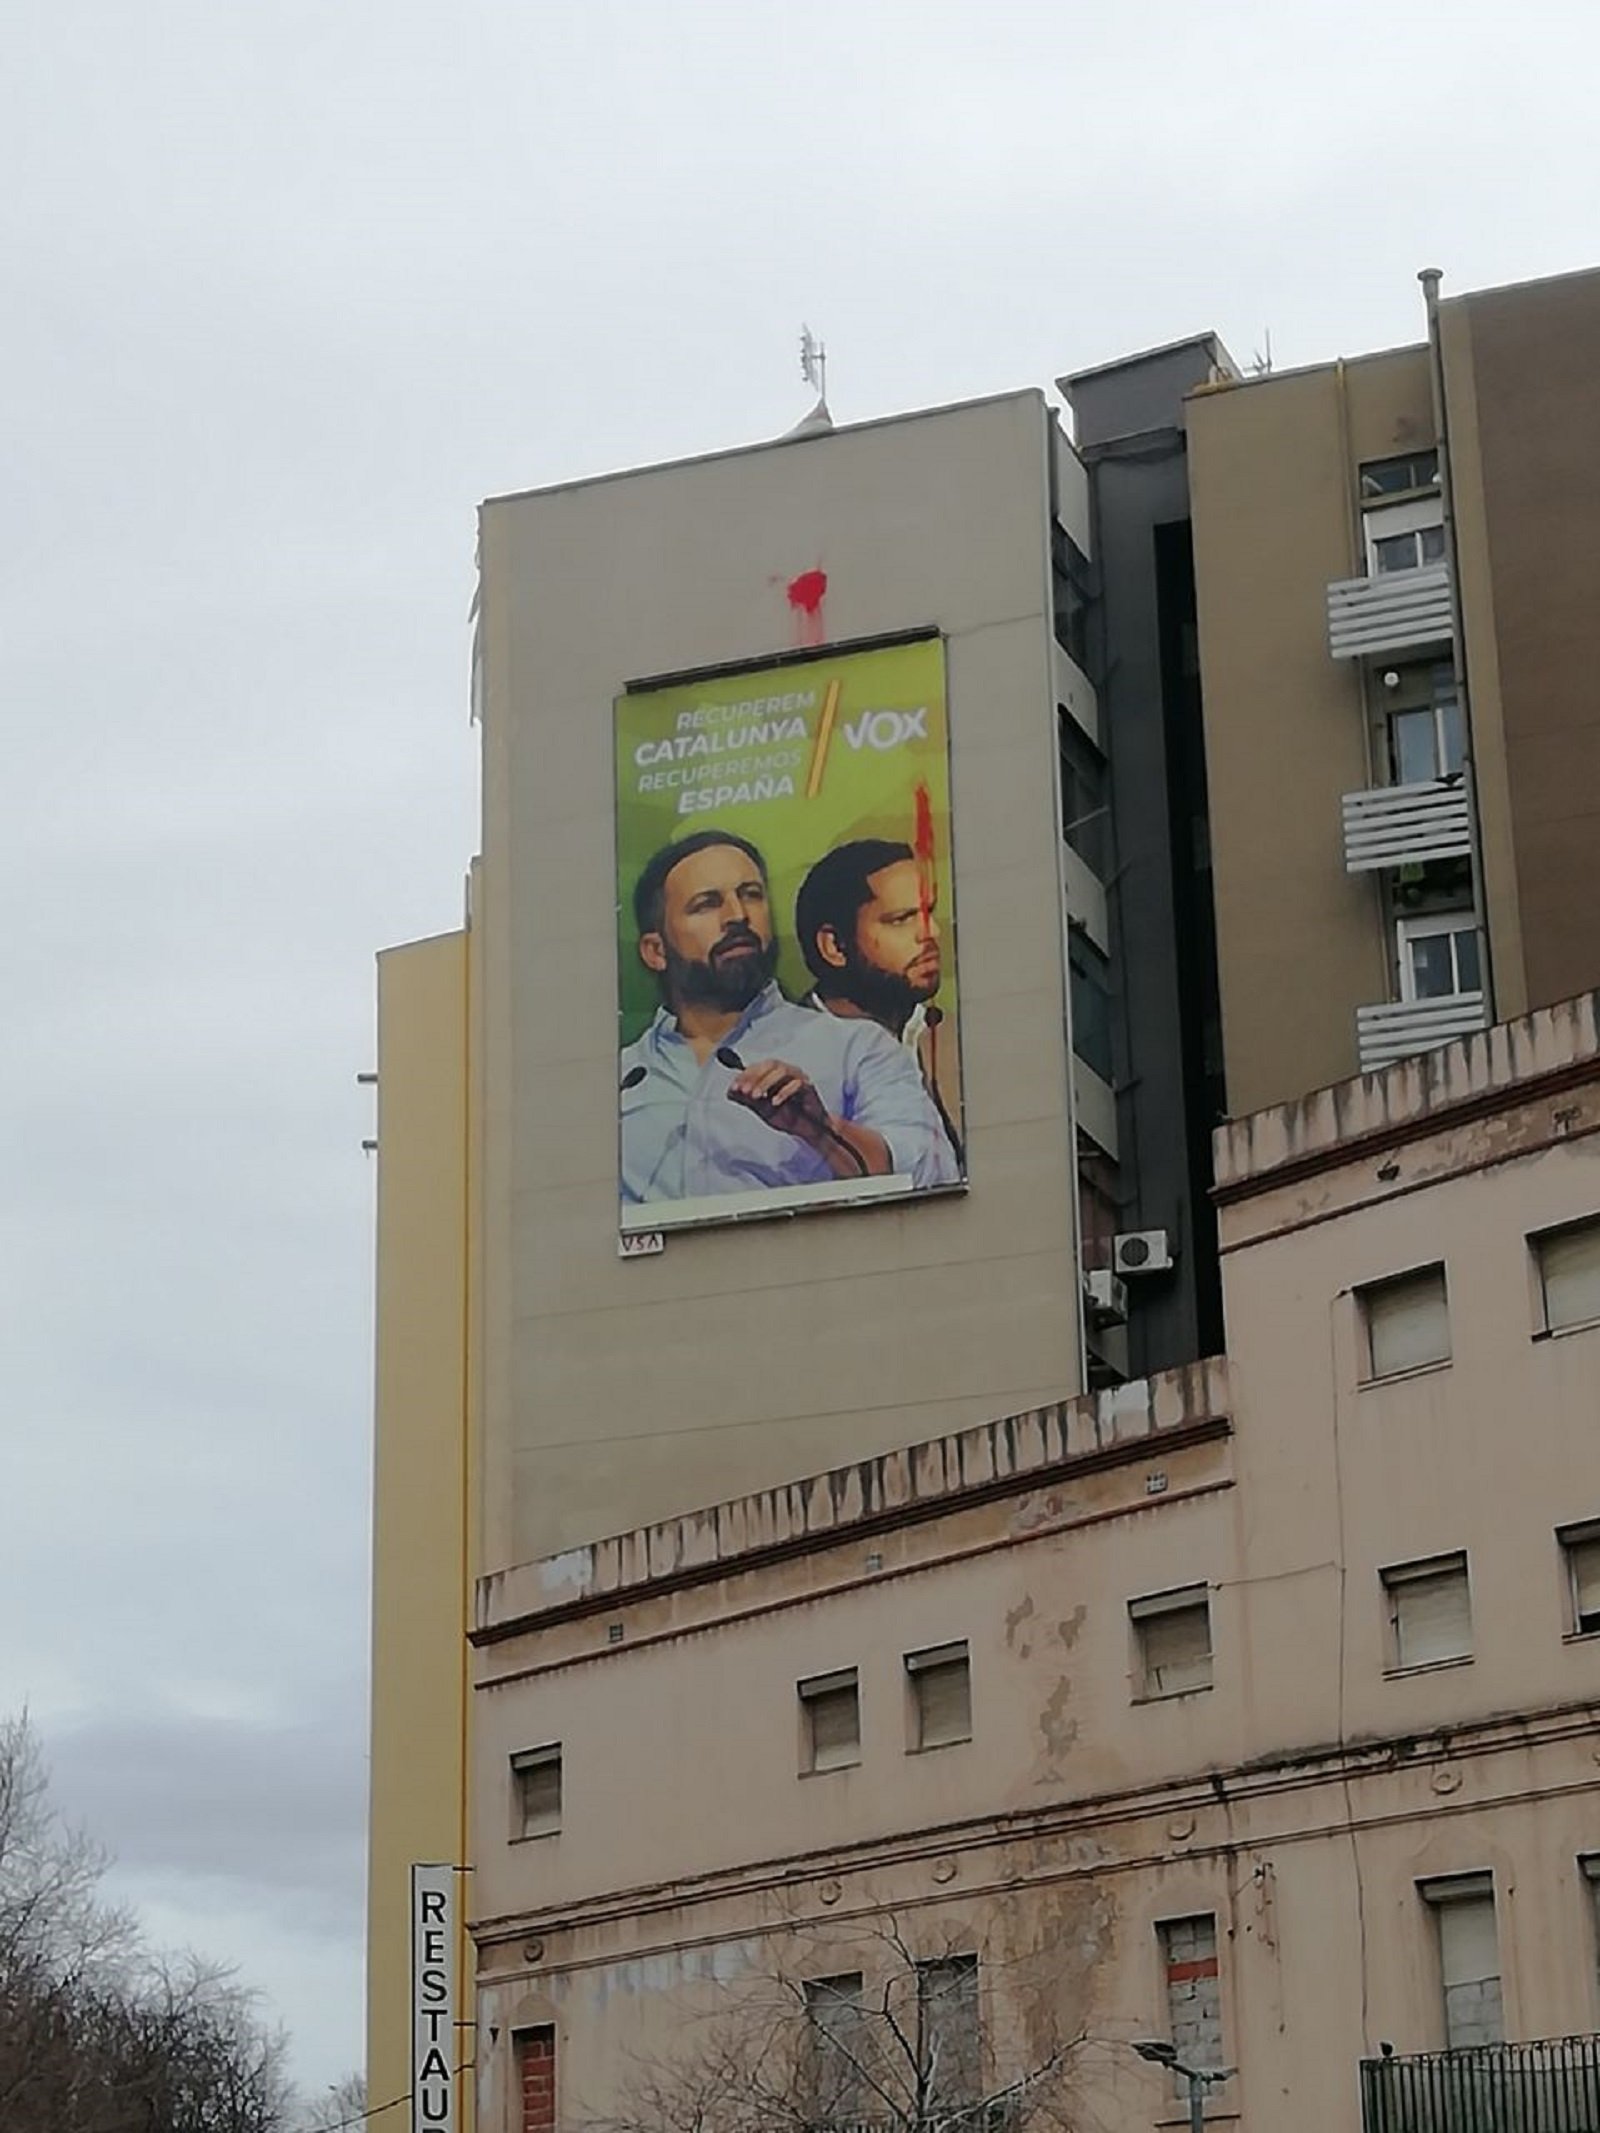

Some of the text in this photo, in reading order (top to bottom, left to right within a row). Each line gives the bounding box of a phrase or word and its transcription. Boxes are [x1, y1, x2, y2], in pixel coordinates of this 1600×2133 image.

[677, 691, 816, 730] RECUPEREM
[844, 708, 927, 750] VOX
[635, 717, 807, 766] CATALUNYA
[638, 750, 801, 792] RECUPEREMOS
[678, 775, 794, 814] ESPAÑA
[420, 1891, 450, 2133] RESTAU
